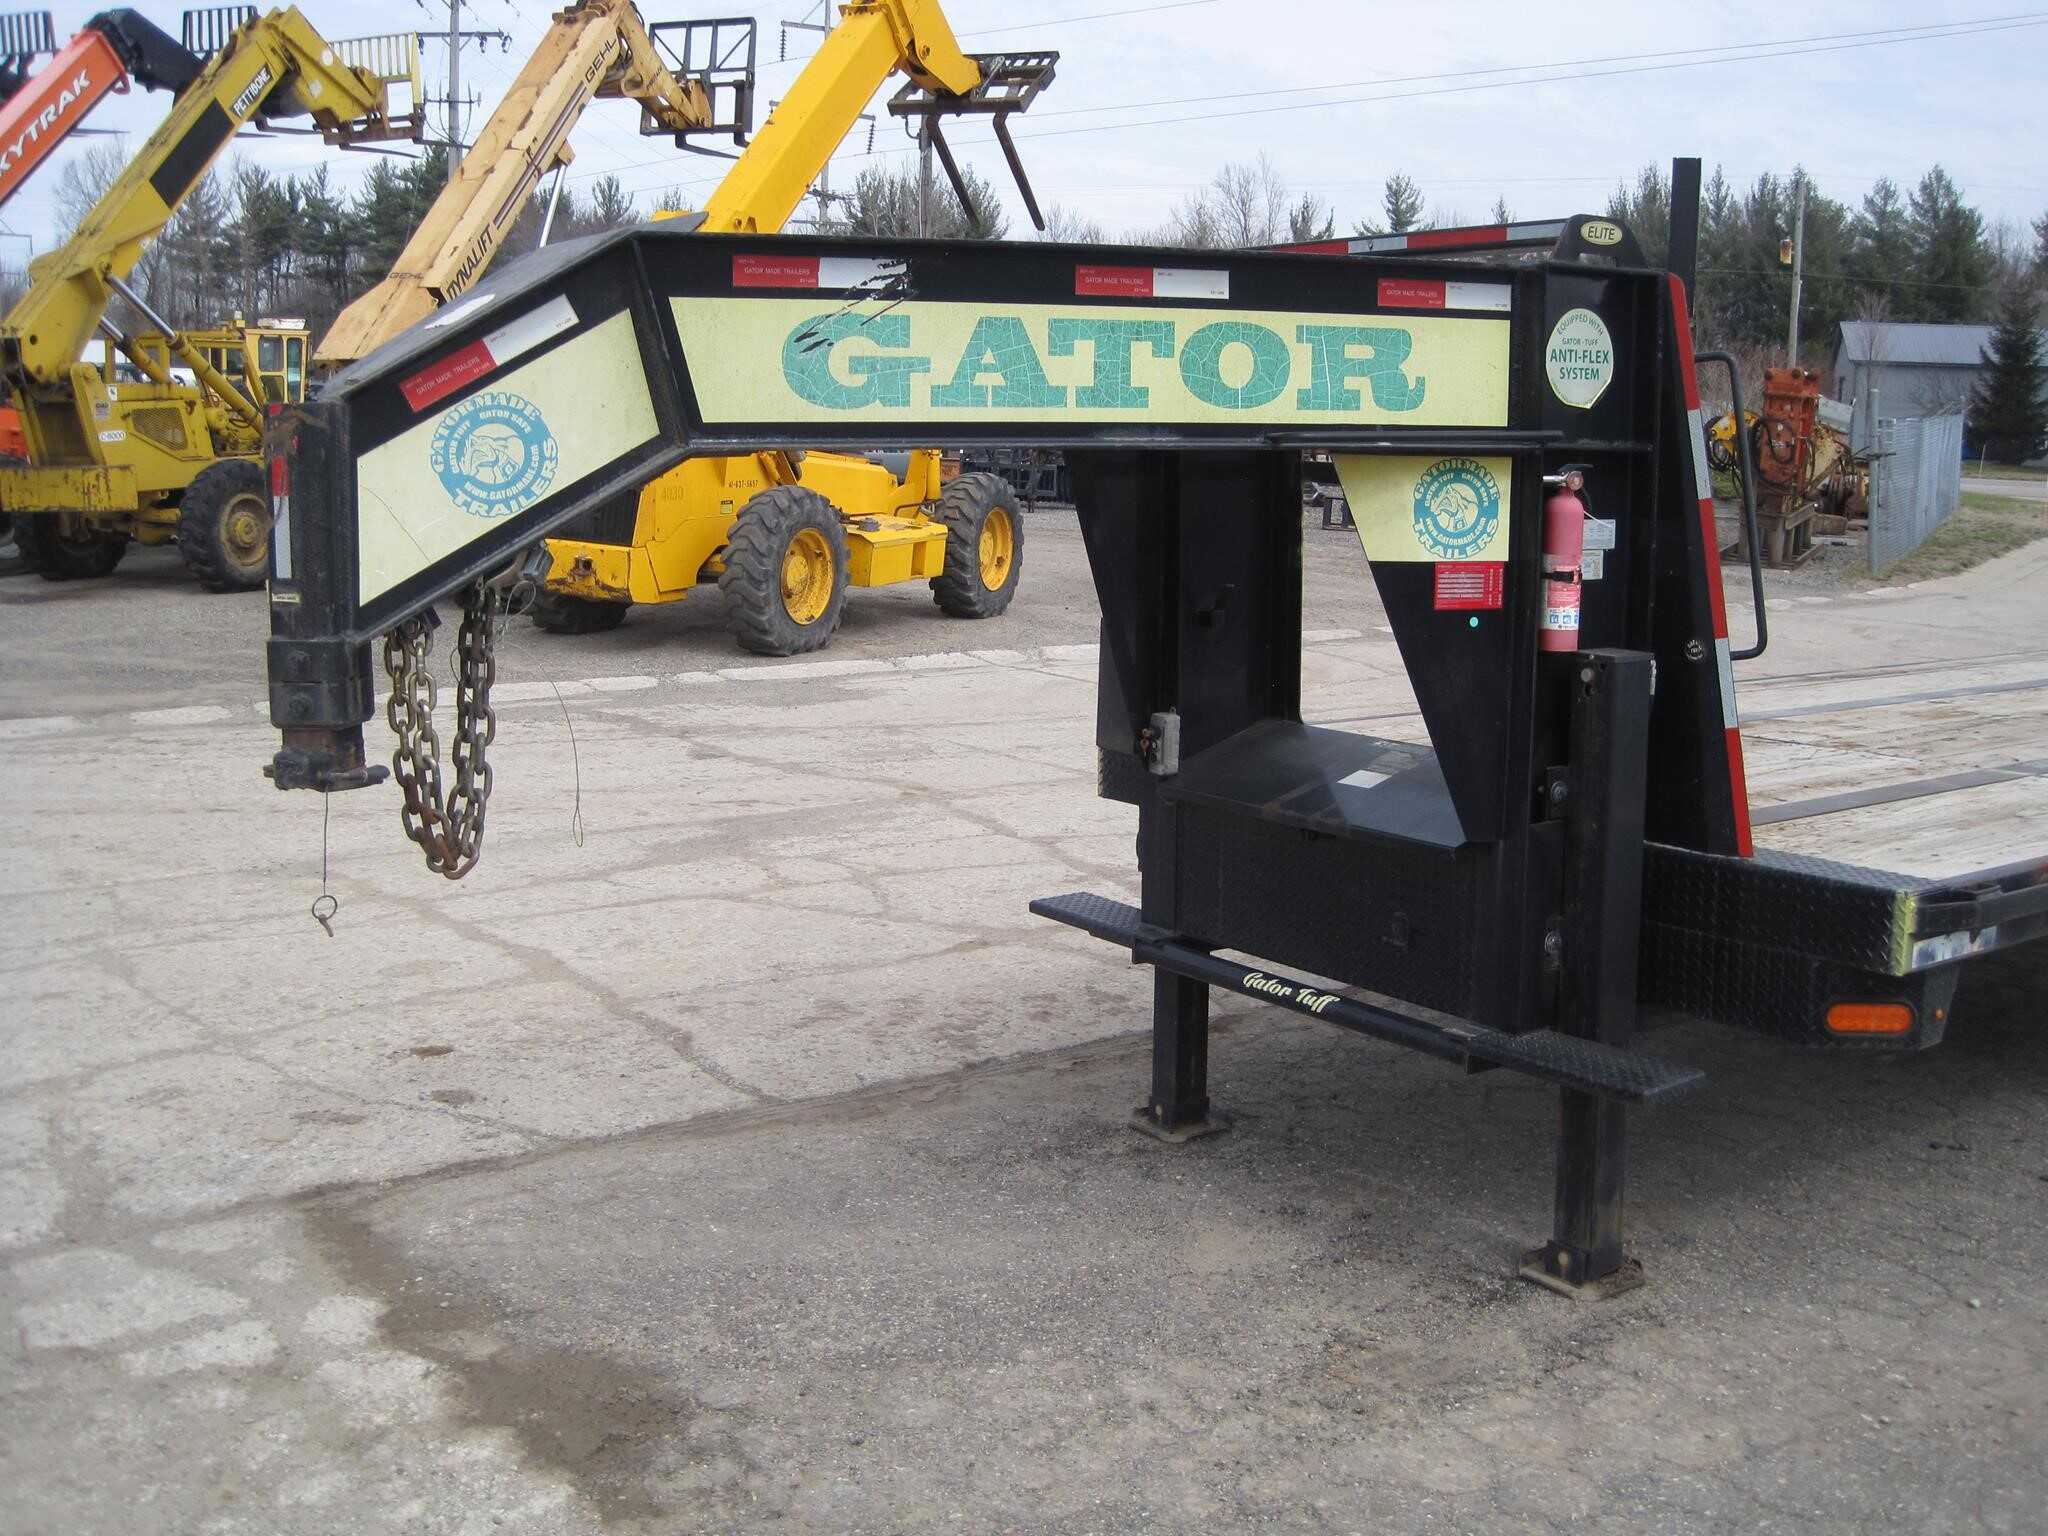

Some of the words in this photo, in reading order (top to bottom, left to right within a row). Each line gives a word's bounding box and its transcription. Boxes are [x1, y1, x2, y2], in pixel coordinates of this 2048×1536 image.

[584, 39, 617, 84] GEHL
[233, 67, 271, 117] PETTIBONE
[1587, 225, 1616, 241] ELITE
[1557, 313, 1588, 336] EQUIPPED
[1588, 317, 1604, 336] WITH
[782, 313, 1426, 412] GATOR
[1551, 348, 1610, 364] ANTI-FLEX
[1560, 366, 1600, 380] SYSTEM
[479, 409, 511, 420] GATOR
[452, 436, 559, 518] TRAILERS
[1413, 517, 1499, 560] TRAILERS
[1242, 972, 1293, 997] Gator
[1295, 988, 1341, 1013] Tuff
